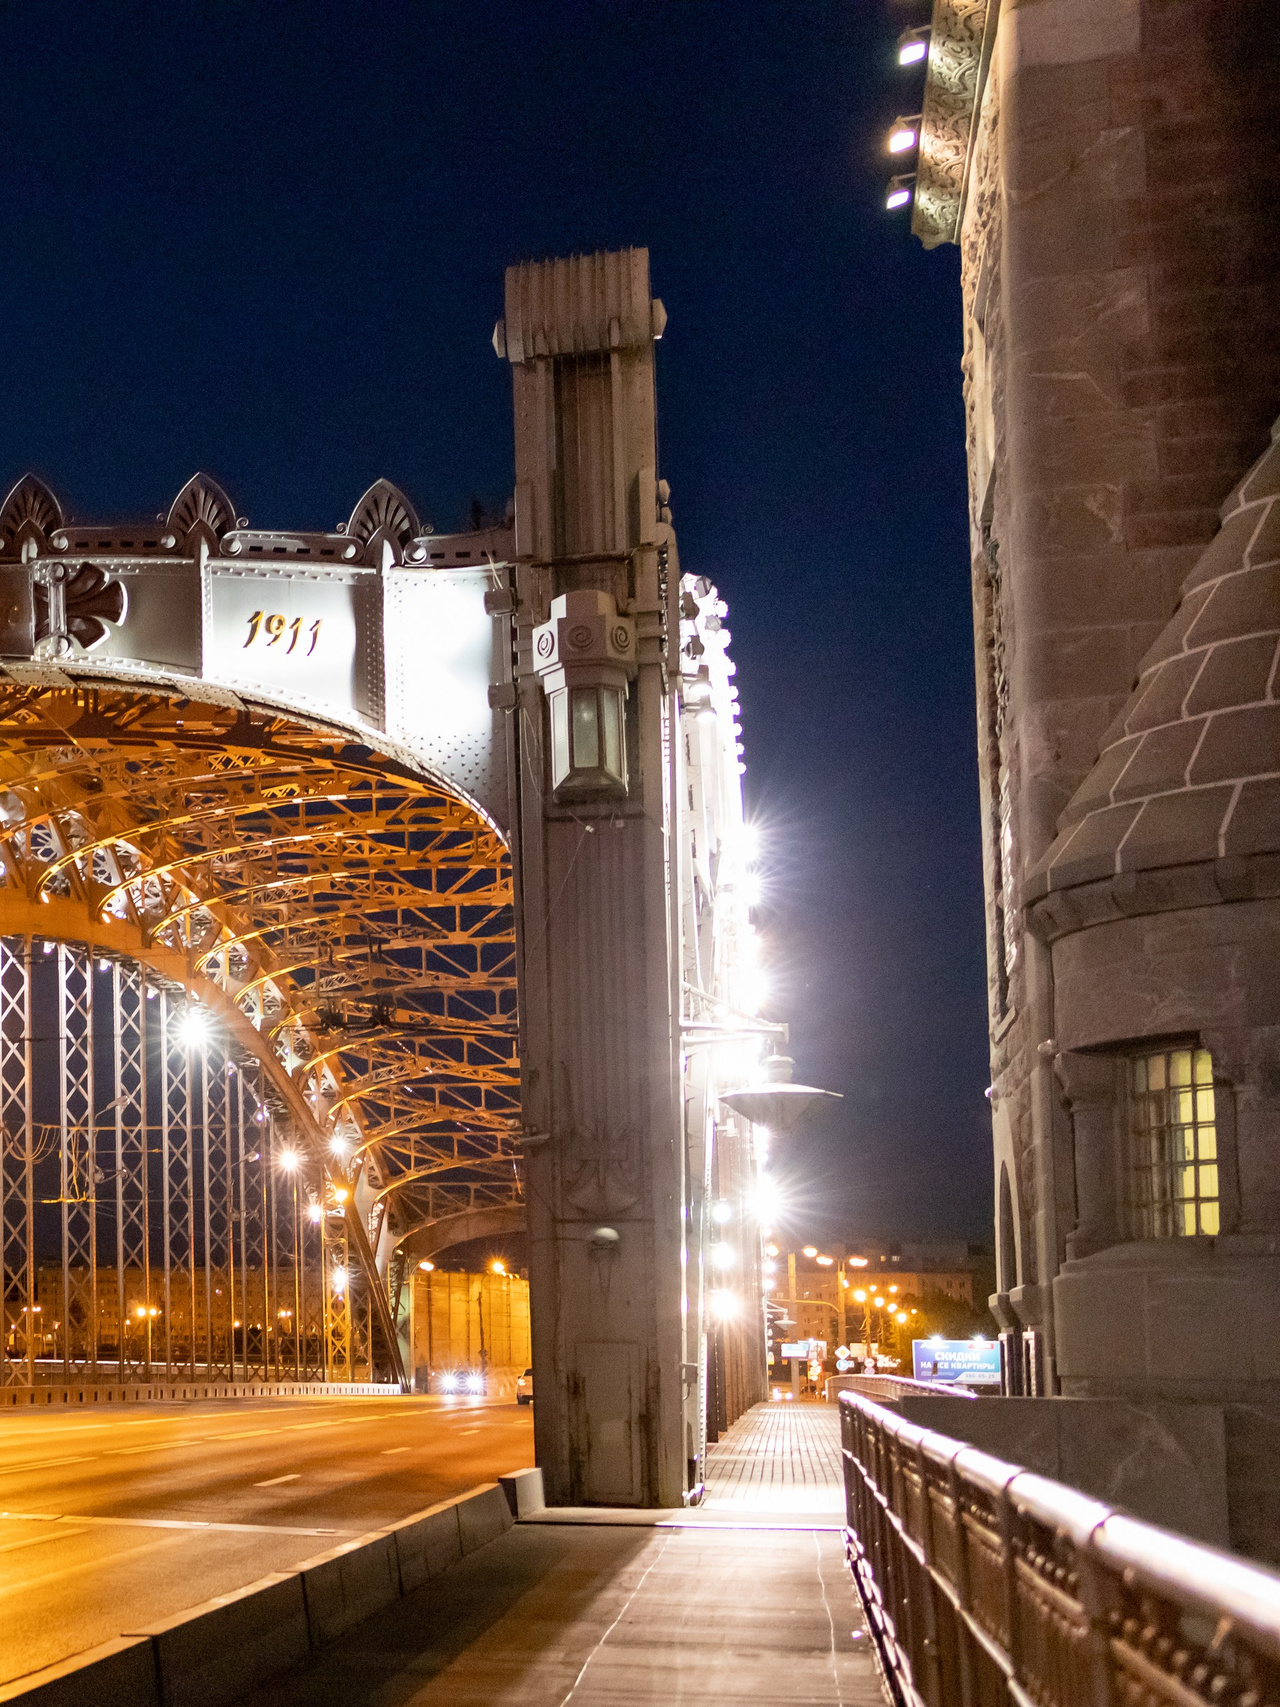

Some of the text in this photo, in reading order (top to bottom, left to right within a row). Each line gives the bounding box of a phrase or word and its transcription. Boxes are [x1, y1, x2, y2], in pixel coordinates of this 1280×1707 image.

[243, 610, 323, 656] 1911
[934, 1351, 980, 1362] СКИДКИ
[920, 1361, 932, 1369] НА
[950, 1362, 995, 1370] КВАРТИРЫ
